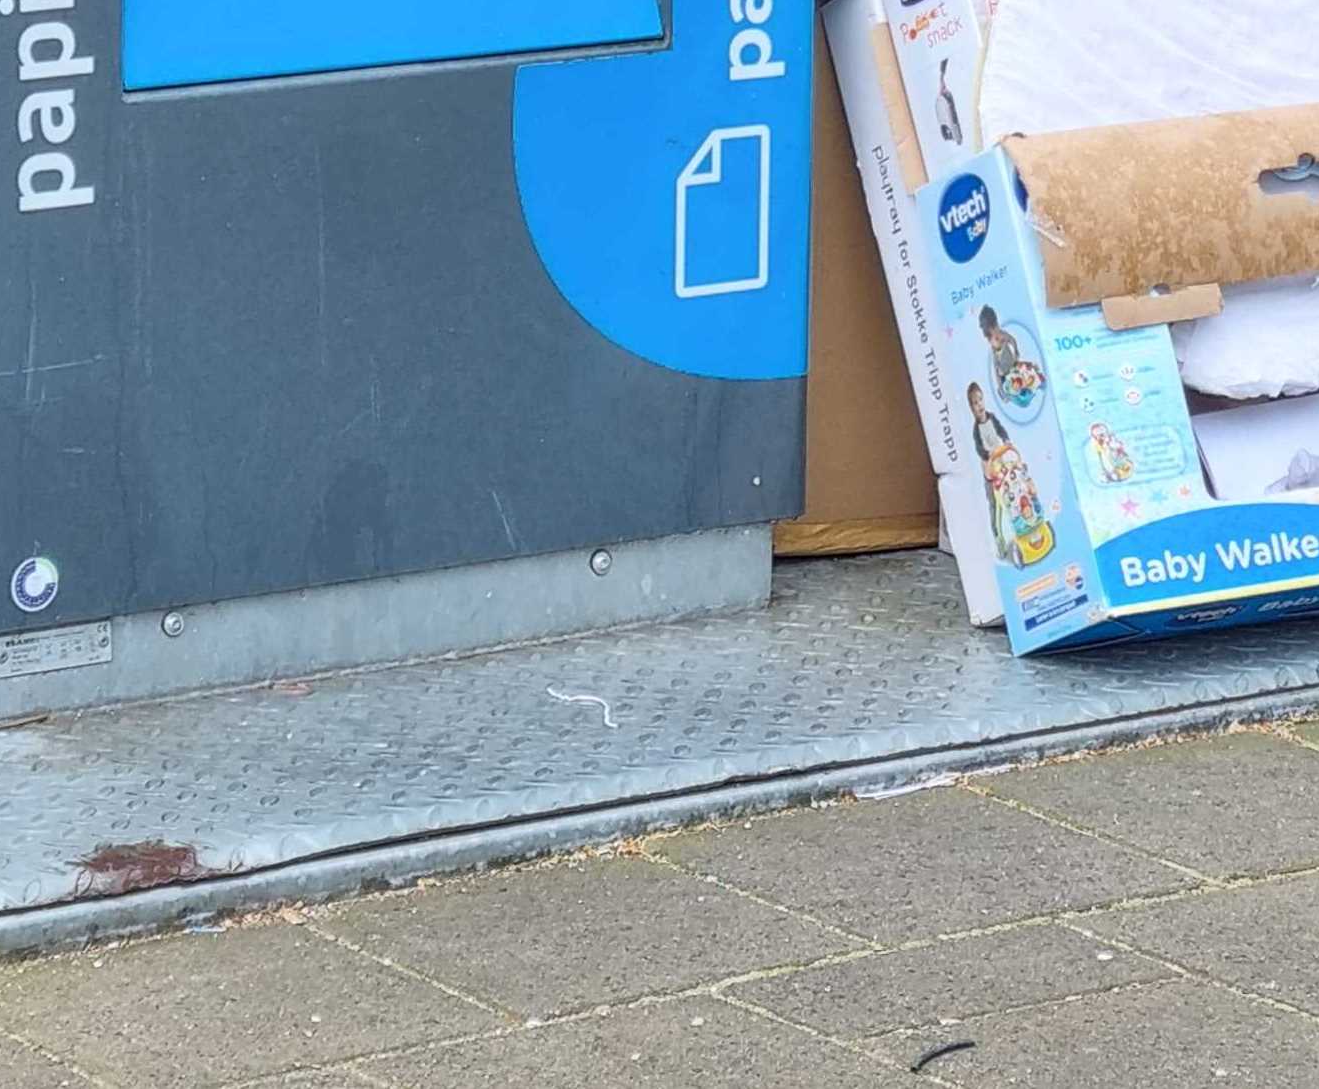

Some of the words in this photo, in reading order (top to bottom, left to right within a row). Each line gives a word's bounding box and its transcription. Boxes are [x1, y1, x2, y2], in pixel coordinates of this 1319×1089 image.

[940, 190, 986, 233] vtech
[872, 145, 902, 235] playtray
[898, 240, 911, 269] for
[907, 275, 928, 343] Stokke
[925, 348, 943, 400] Tripp
[939, 404, 959, 462] Trapp
[951, 286, 975, 305] Baby
[976, 266, 1008, 289] Walker
[1054, 334, 1092, 351] 100+
[1120, 549, 1206, 588] Baby
